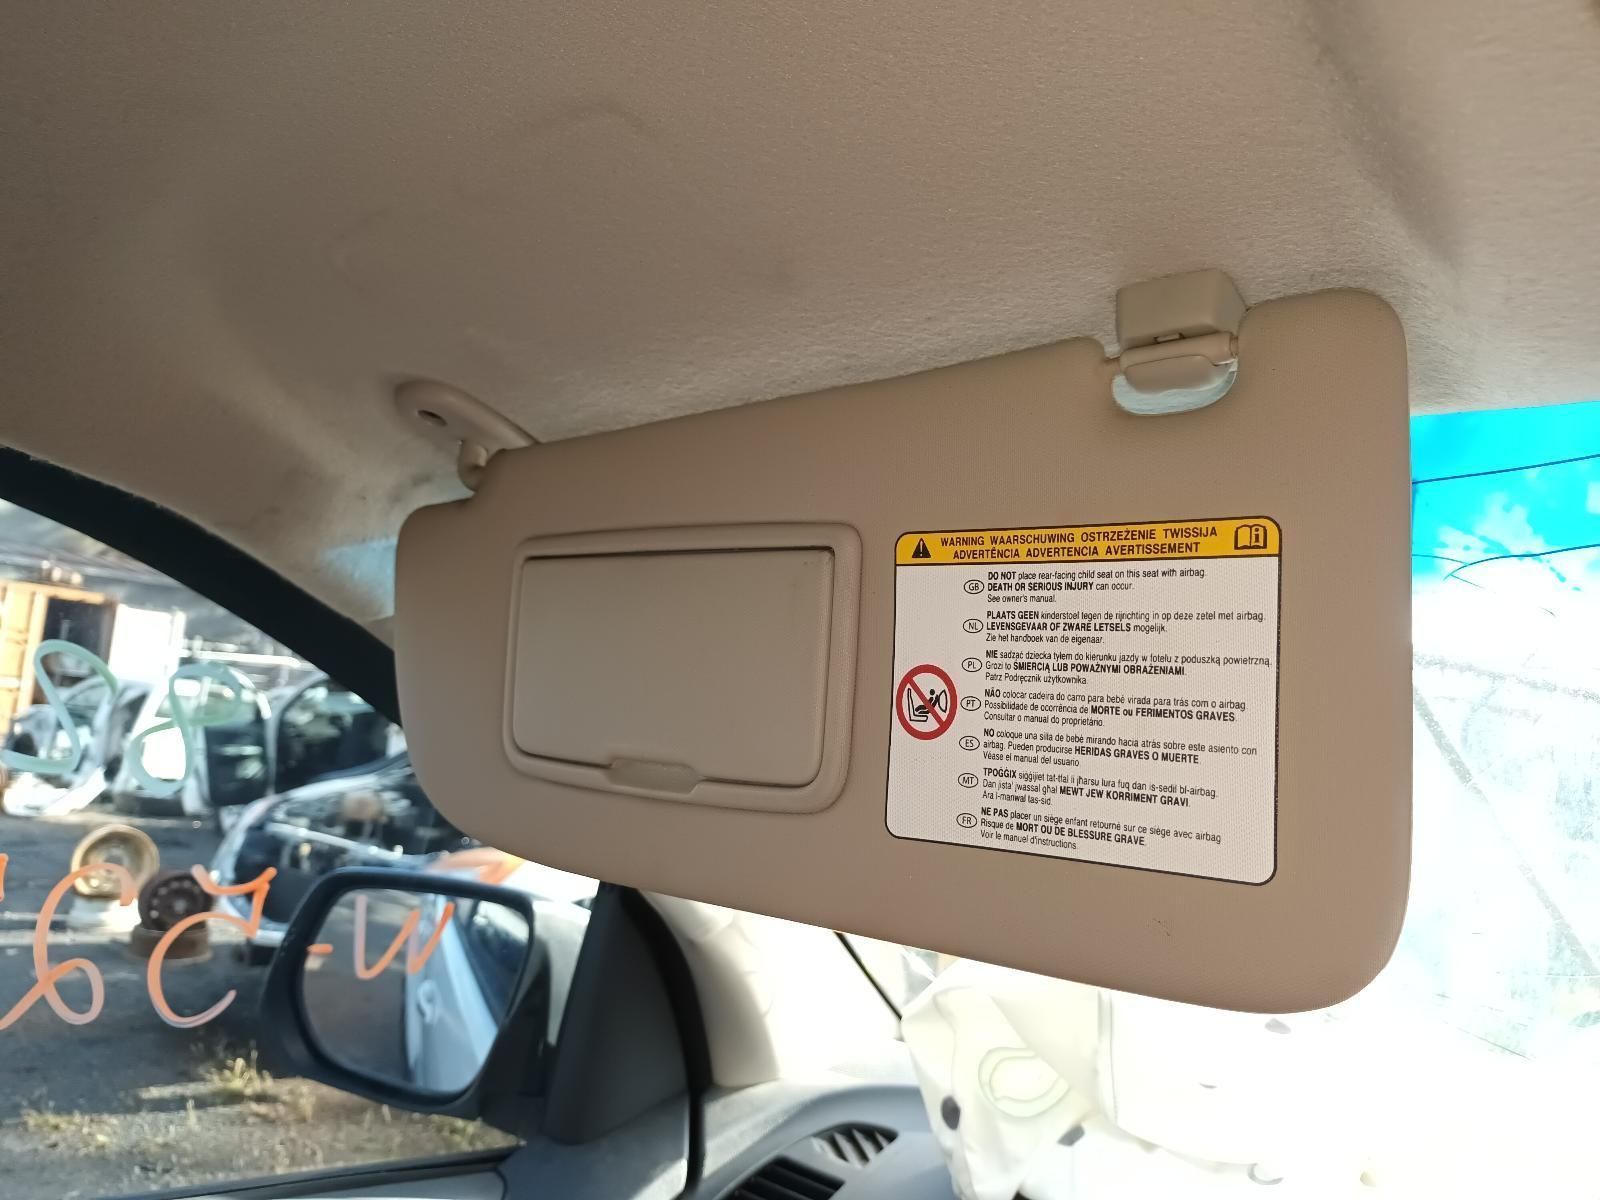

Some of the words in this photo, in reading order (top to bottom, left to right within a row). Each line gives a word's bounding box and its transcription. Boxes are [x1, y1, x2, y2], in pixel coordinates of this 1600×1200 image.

[940, 535, 984, 547] WARNING
[990, 532, 1074, 545] WAARSCHUWING
[1080, 527, 1156, 542] OSTRZEŻENIE
[1163, 527, 1217, 539] TWISSIJA
[952, 546, 1020, 560] ADVERTÊNCIA
[1025, 545, 1098, 558] ADVERTENCIA
[1105, 542, 1200, 555] AVERTISSEMENT
[987, 571, 998, 580] DO
[1000, 571, 1016, 580] NOT
[1018, 571, 1036, 582] place
[1038, 570, 1075, 582] rear-facing
[1077, 570, 1094, 579] child
[1096, 570, 1112, 579] seat
[1126, 569, 1140, 578] this
[1142, 569, 1158, 578] seat
[1161, 569, 1176, 578] with
[987, 582, 1012, 592] DEATH
[1014, 582, 1025, 591] OR
[1027, 582, 1062, 591] SERIOUS
[1064, 581, 1093, 591] INJURY
[987, 594, 1000, 603] See
[1002, 594, 1028, 603] owner's
[1029, 594, 1056, 603] manual.
[986, 611, 1016, 620] PLAATS
[1017, 611, 1038, 620] GEEN
[1040, 611, 1079, 620] kinderstoel
[1081, 611, 1101, 622] tegen
[1103, 611, 1113, 620] de
[1152, 612, 1159, 621] in
[1161, 613, 1171, 623] op
[1173, 612, 1193, 621] deze
[1195, 612, 1215, 621] zetel
[1218, 612, 1233, 621] met
[986, 622, 1047, 631] LEVENSGEVAAR
[1049, 622, 1060, 631] OF
[1062, 622, 1091, 631] ZWARE
[1093, 623, 1131, 632] LETSELS
[1133, 623, 1167, 634] mogelijk.
[985, 633, 996, 642] Zie
[998, 633, 1008, 642] het
[1010, 633, 1043, 642] handboek
[1045, 635, 1058, 643] van
[1060, 634, 1068, 643] de
[1071, 634, 1104, 645] eigenaar.
[985, 649, 998, 658] NIE
[1025, 650, 1051, 660] dziecka
[1074, 652, 1083, 661] do
[1085, 652, 1116, 661] kierunku
[1118, 653, 1138, 664] jazdy
[1181, 654, 1220, 666] poduszką
[985, 661, 1003, 670] Grozi
[1005, 661, 1011, 670] to
[1052, 663, 1068, 672] LUB
[985, 672, 1002, 682] Patrz
[984, 686, 1000, 698] NÃO
[1002, 689, 1026, 699] colocar
[1028, 690, 1054, 700] cadeira
[1056, 691, 1064, 701] do
[1087, 695, 1104, 705] para
[1106, 694, 1124, 703] bebé
[1127, 694, 1150, 704] virada
[1153, 697, 1171, 708] para
[1173, 697, 1188, 706] trás
[1191, 699, 1208, 707] com
[984, 700, 1028, 711] Possibilidade
[1030, 702, 1038, 712] de
[1079, 705, 1088, 714] de
[1090, 705, 1120, 716] MORTE
[1135, 708, 1193, 720] FERIMENTOS
[983, 711, 1015, 722] Consultar
[1023, 713, 1048, 723] manual
[1050, 715, 1059, 724] do
[983, 728, 994, 737] NO
[996, 729, 1022, 741] coloque
[1024, 732, 1037, 740] una
[1054, 732, 1064, 742] de
[1065, 733, 1084, 743] bebé
[1086, 734, 1116, 745] mirando
[1118, 737, 1138, 747] hacia
[1141, 738, 1160, 748] atrás
[1163, 740, 1185, 750] sobre
[1188, 741, 1205, 751] este
[1208, 743, 1238, 753] asiento
[1241, 747, 1256, 755] con
[1005, 752, 1011, 762] el
[1013, 753, 1038, 764] manual
[1040, 755, 1051, 764] del
[1007, 741, 1033, 752] Pueden
[1035, 743, 1072, 757] producirse
[1074, 746, 1111, 758] HERIDAS
[1113, 749, 1149, 760] GRAVES
[1152, 752, 1158, 761] O
[1101, 777, 1115, 787] lura
[1118, 779, 1129, 791] fuq
[1131, 780, 1146, 790] dan
[982, 779, 996, 789] Dan
[1014, 782, 1040, 795] jwassal
[1059, 786, 1084, 797] MEWT
[1085, 789, 1103, 799] JEW
[1106, 791, 1157, 804] KORRIMENT
[982, 790, 994, 800] Ara
[981, 806, 991, 816] NE
[993, 808, 1008, 818] PAS
[1010, 810, 1031, 823] placer
[1033, 814, 1041, 822] un
[1043, 813, 1062, 826] siège
[1064, 816, 1087, 827] enfant
[1090, 818, 1120, 831] retourné
[1123, 824, 1135, 832] sur
[1137, 825, 1147, 834] ce
[1149, 825, 1170, 838] siège
[1173, 829, 1192, 838] avec
[980, 818, 1003, 832] Risque
[1005, 821, 1013, 830] de
[1016, 822, 1038, 833] MORT
[1040, 825, 1052, 835] OU
[1054, 826, 1065, 836] DE
[1067, 828, 1111, 842] BLESSURE
[980, 829, 994, 840] Voir
[995, 831, 1002, 841] le
[1003, 832, 1028, 844] manuel
